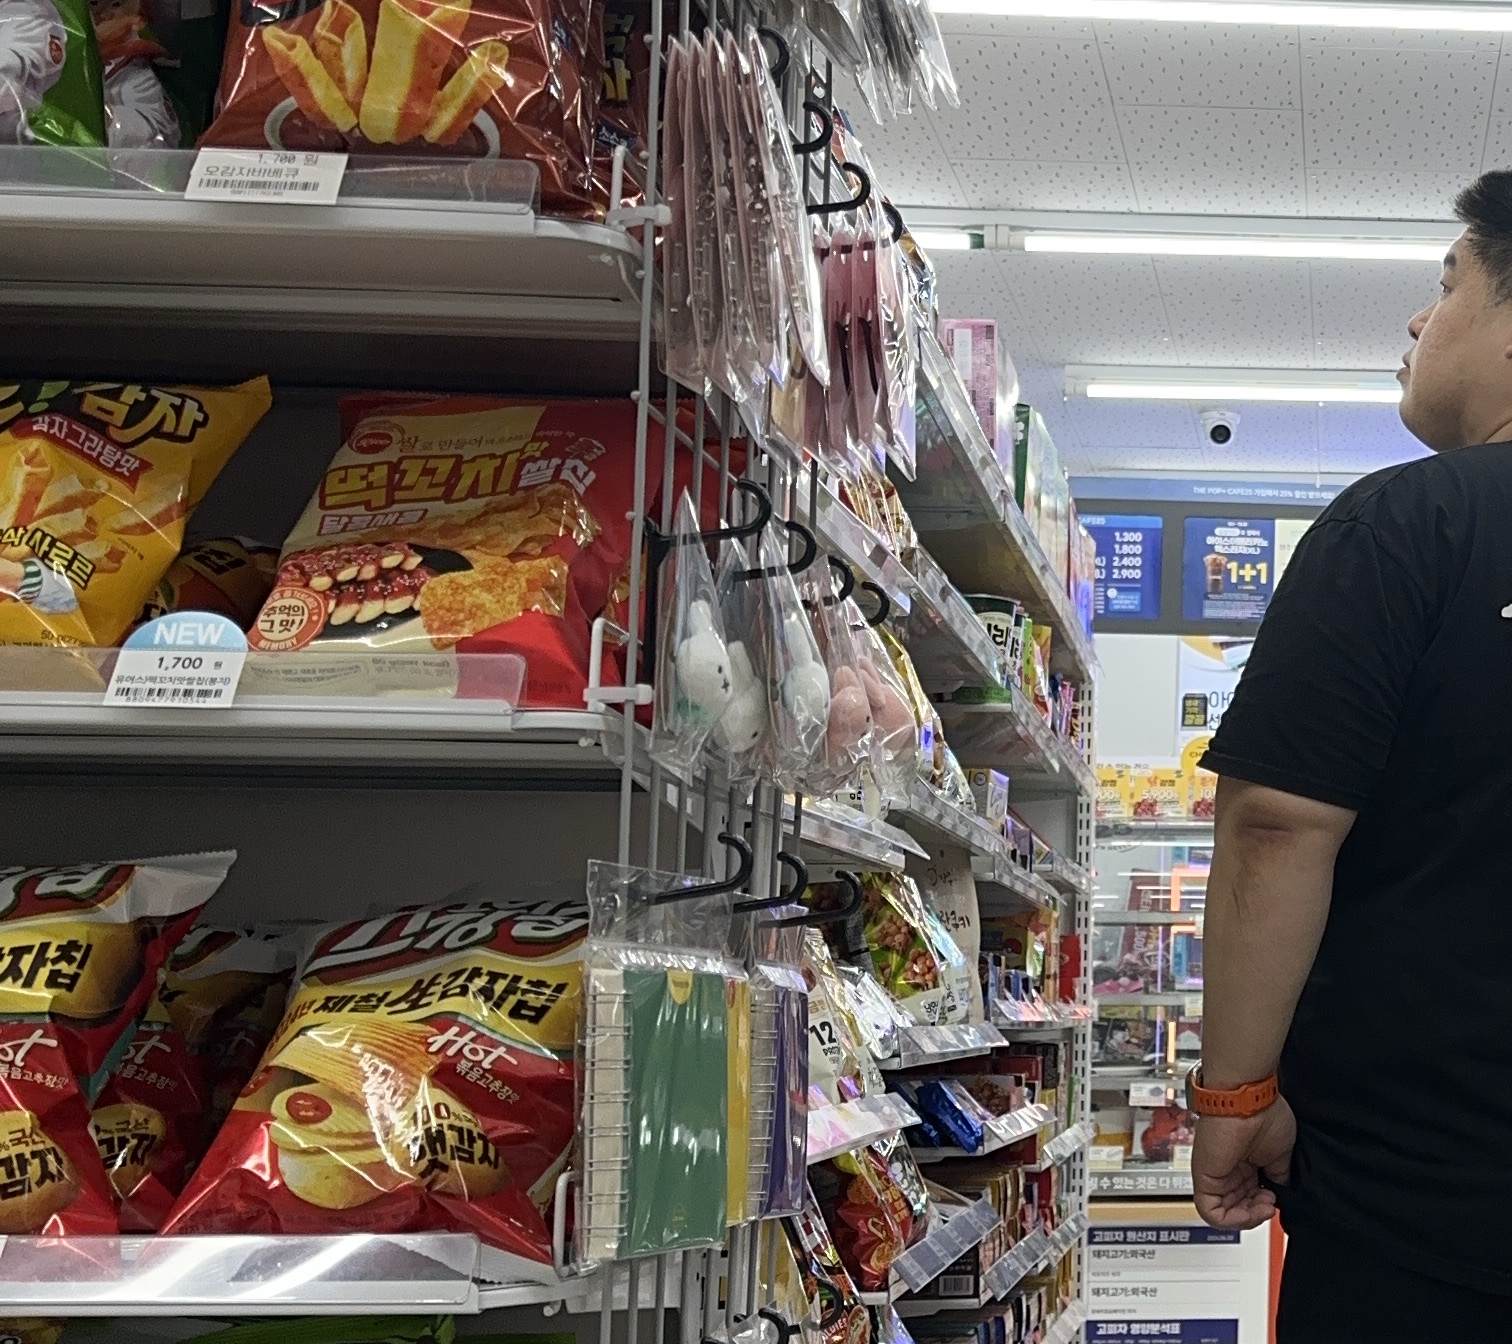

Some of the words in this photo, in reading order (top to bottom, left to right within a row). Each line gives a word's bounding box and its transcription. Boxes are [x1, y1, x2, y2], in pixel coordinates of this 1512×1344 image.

[203, 165, 300, 180] 오감자바베큐
[1193, 486, 1206, 495] THE
[25, 526, 97, 591] 사르르
[1226, 561, 1268, 585] 1+1
[261, 603, 306, 619] 추억의
[153, 622, 226, 646] NEW
[259, 619, 276, 634] 그
[157, 656, 204, 672] 1,700
[313, 989, 392, 1015] 제철
[427, 1025, 519, 1070] Hot
[1099, 1176, 1112, 1190] 수
[1112, 1176, 1135, 1190] 있는
[1135, 1176, 1158, 1190] 것은
[1159, 1176, 1171, 1189] 다
